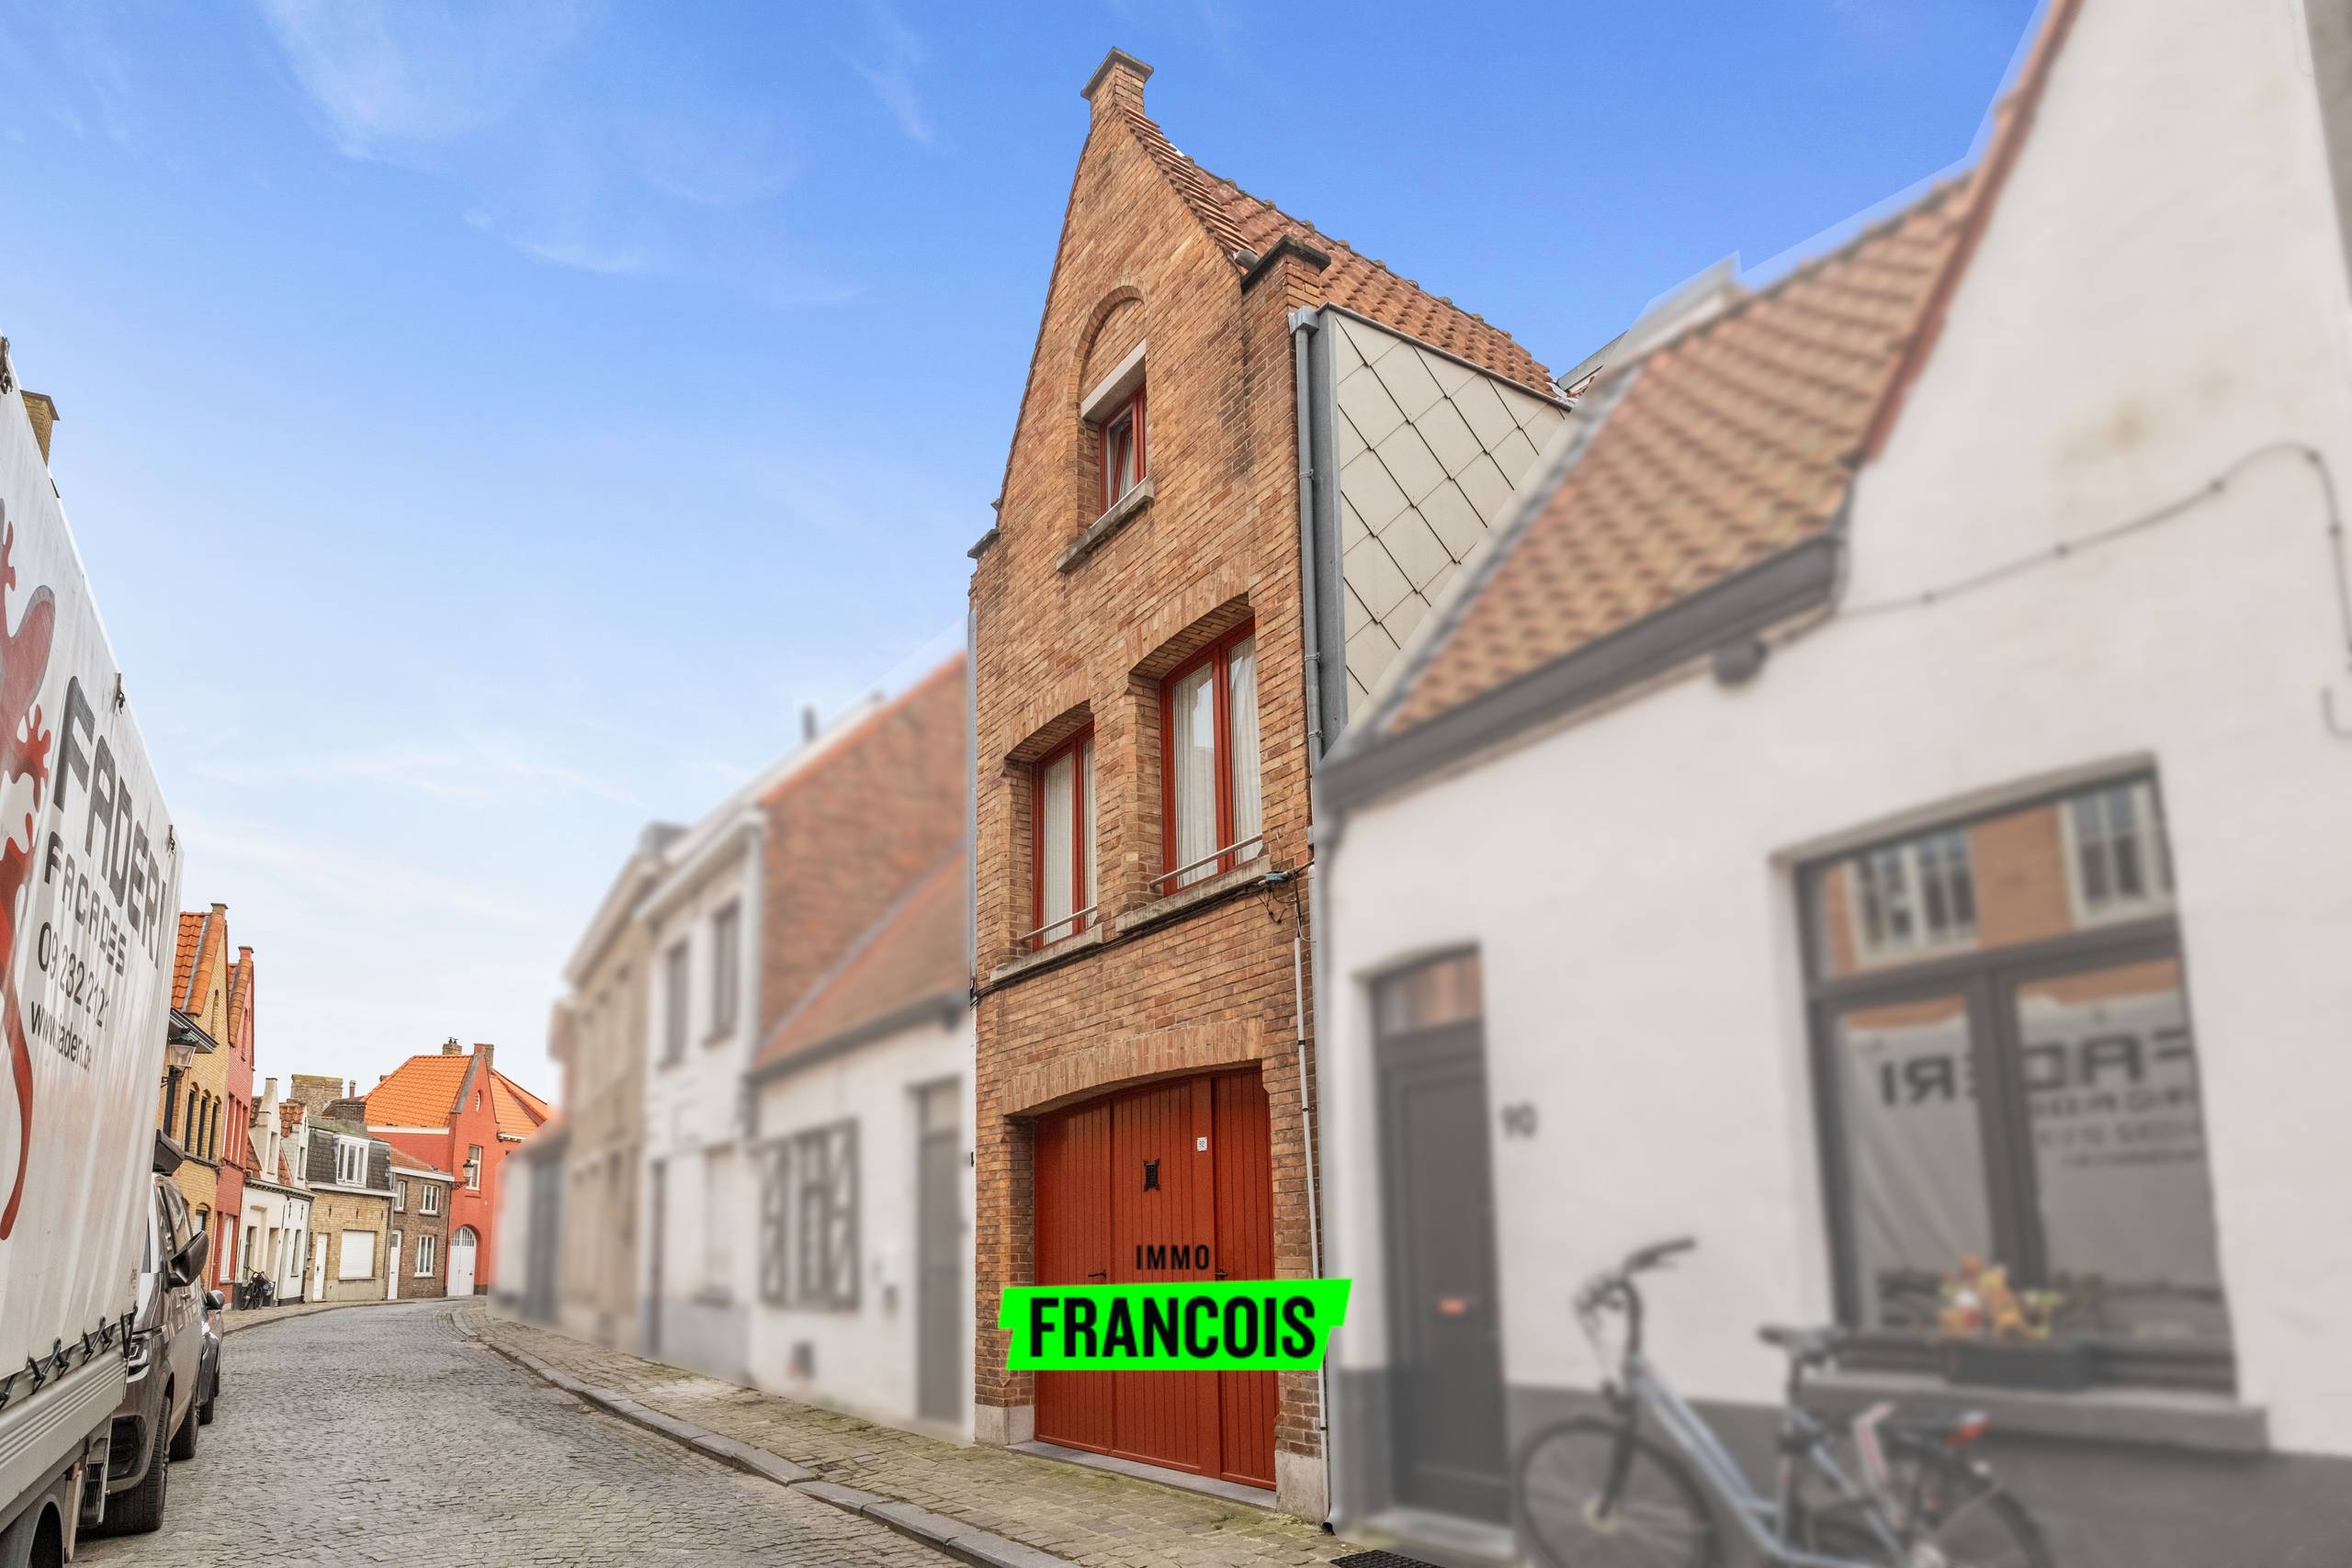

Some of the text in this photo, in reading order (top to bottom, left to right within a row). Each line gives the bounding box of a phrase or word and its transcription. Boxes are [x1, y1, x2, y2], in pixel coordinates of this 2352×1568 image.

[54, 675, 166, 970] FADERI
[38, 921, 58, 980] 09
[60, 944, 85, 1006] 232
[44, 830, 127, 976] FACADES
